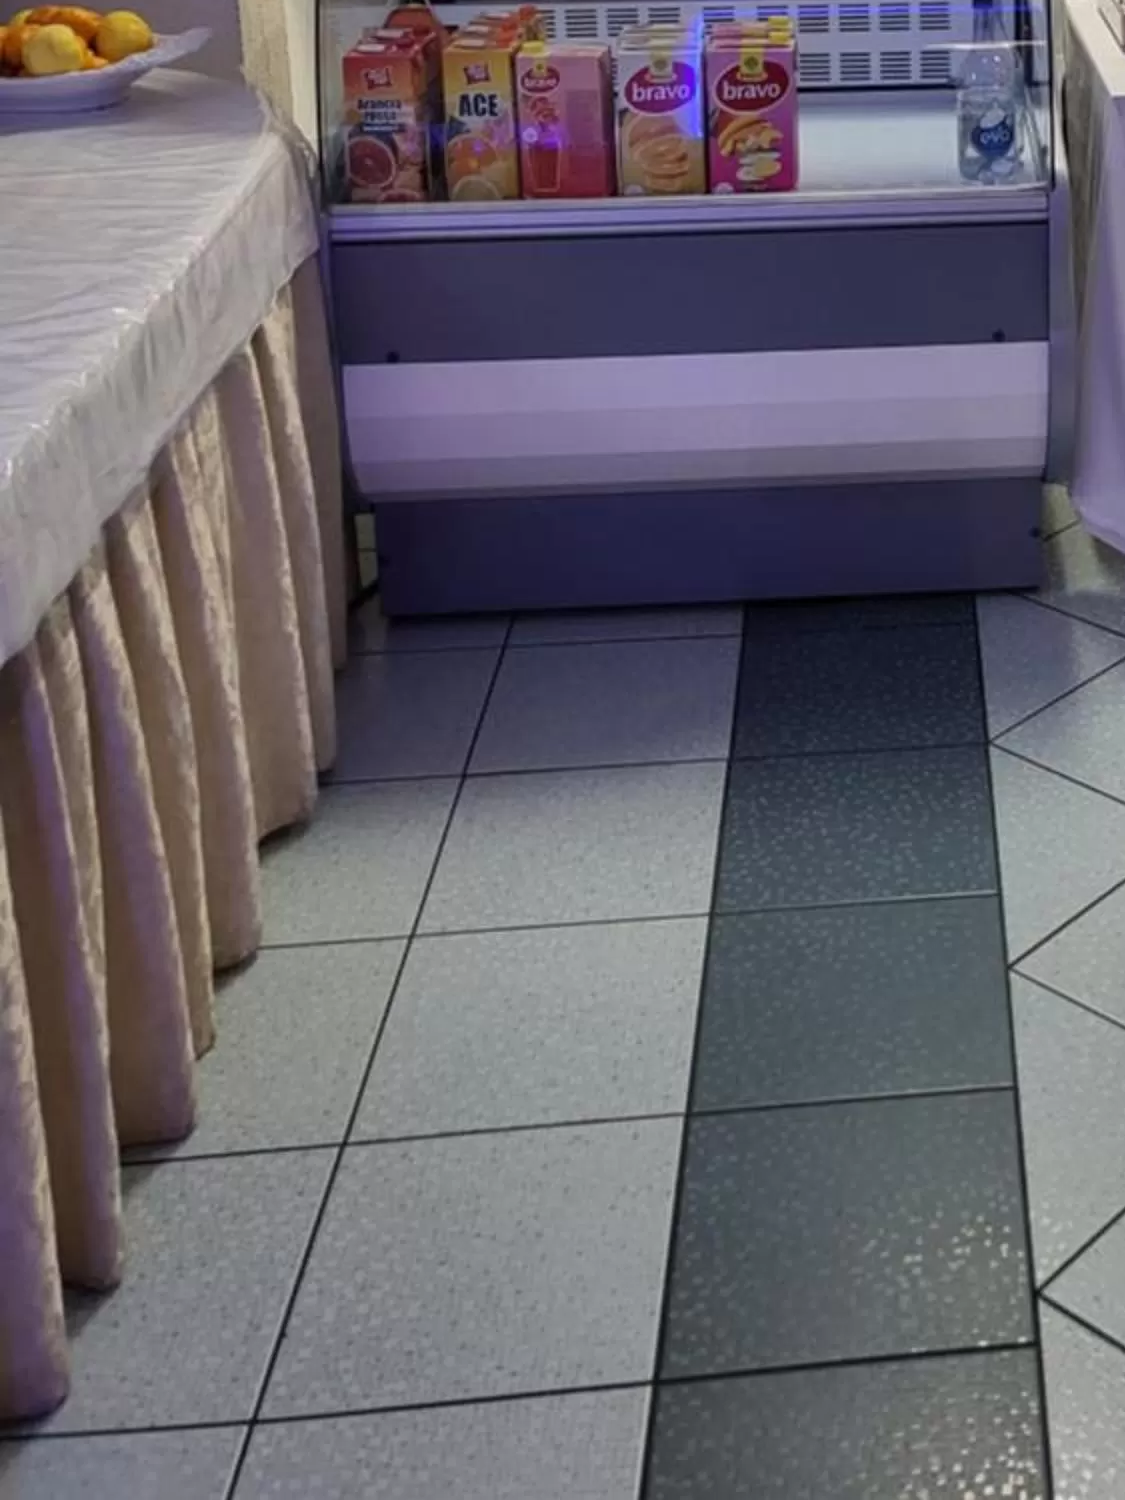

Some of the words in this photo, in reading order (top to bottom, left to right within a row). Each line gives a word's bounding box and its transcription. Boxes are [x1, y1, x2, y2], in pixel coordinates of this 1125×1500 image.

[631, 81, 692, 101] bravo
[722, 81, 781, 100] bravo
[458, 93, 499, 117] ACE
